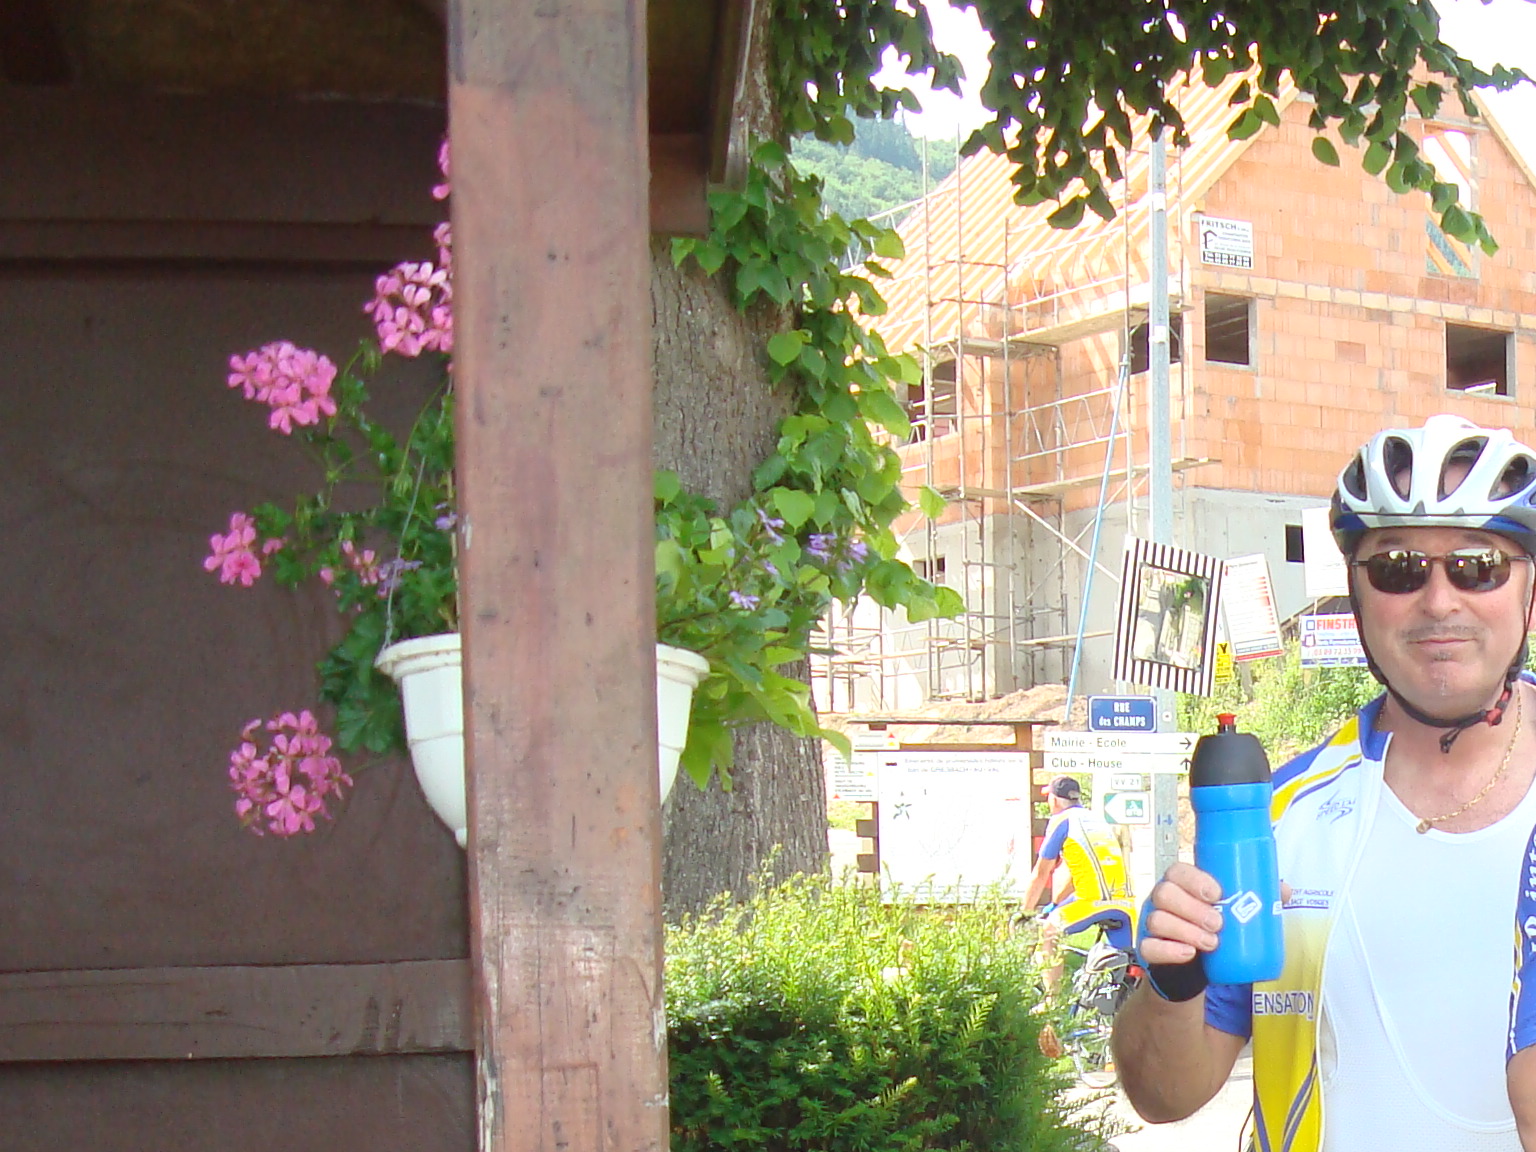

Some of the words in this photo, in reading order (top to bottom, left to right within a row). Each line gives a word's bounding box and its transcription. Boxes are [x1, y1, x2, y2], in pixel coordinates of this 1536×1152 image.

[1113, 702, 1130, 713] RUE
[1098, 716, 1111, 726] des
[1113, 716, 1146, 727] CHAMPS
[1051, 737, 1085, 748] Mairie
[1051, 757, 1077, 768] Club
[1088, 758, 1122, 768] House
